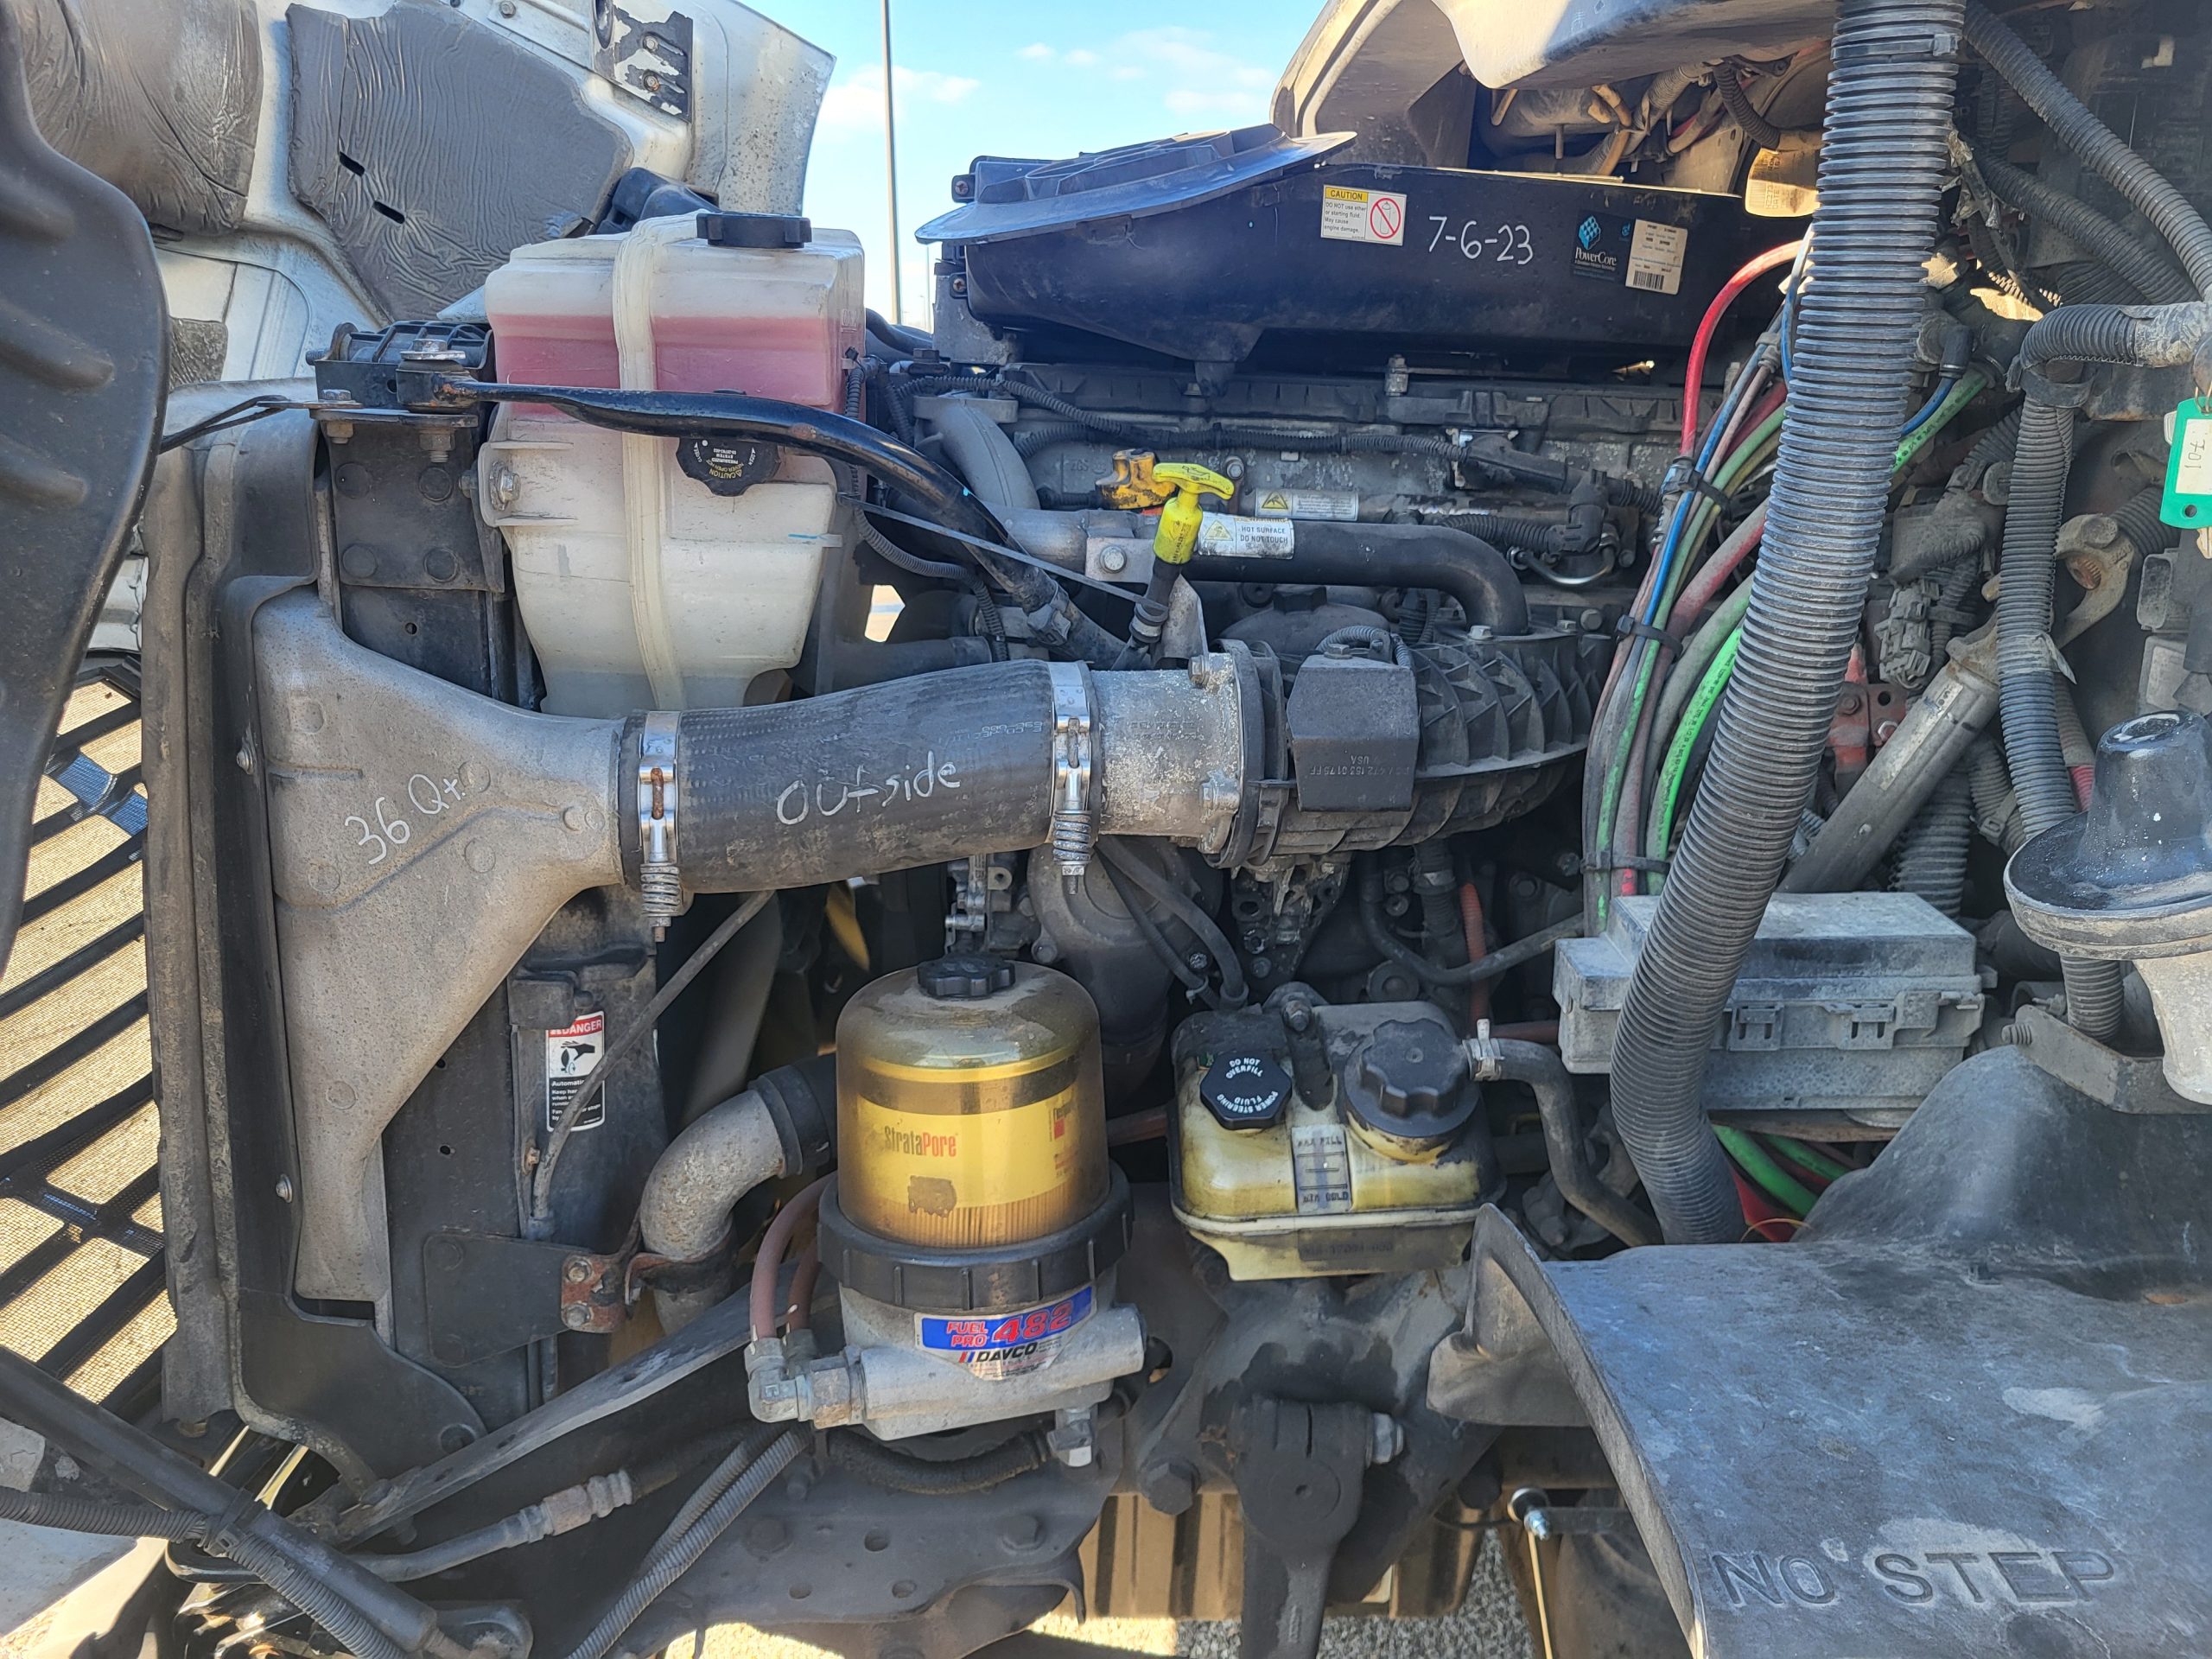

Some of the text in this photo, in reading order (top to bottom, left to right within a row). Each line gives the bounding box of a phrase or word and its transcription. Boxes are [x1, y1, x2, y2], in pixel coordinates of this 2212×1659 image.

[1331, 190, 1363, 200] CAUTION
[1429, 216, 1534, 264] 7-6-23
[1574, 246, 1618, 266] PowerCore
[709, 468, 736, 479] CAUTION
[1266, 536, 1288, 544] TOUCH
[1351, 755, 1370, 764] USA
[345, 797, 410, 864] 36
[1229, 1058, 1261, 1068] DO NOT
[1225, 1065, 1264, 1079] OVERFILL
[1217, 1090, 1279, 1114] POWER STEERING
[1234, 1095, 1262, 1106] FLUID
[884, 1125, 957, 1158] StrataPore
[946, 1320, 989, 1335] FUEL
[991, 1300, 1074, 1344] 482
[950, 1334, 988, 1348] PRO
[976, 1341, 1039, 1363] DAVCO
[1710, 1551, 2114, 1605] NO STEP
